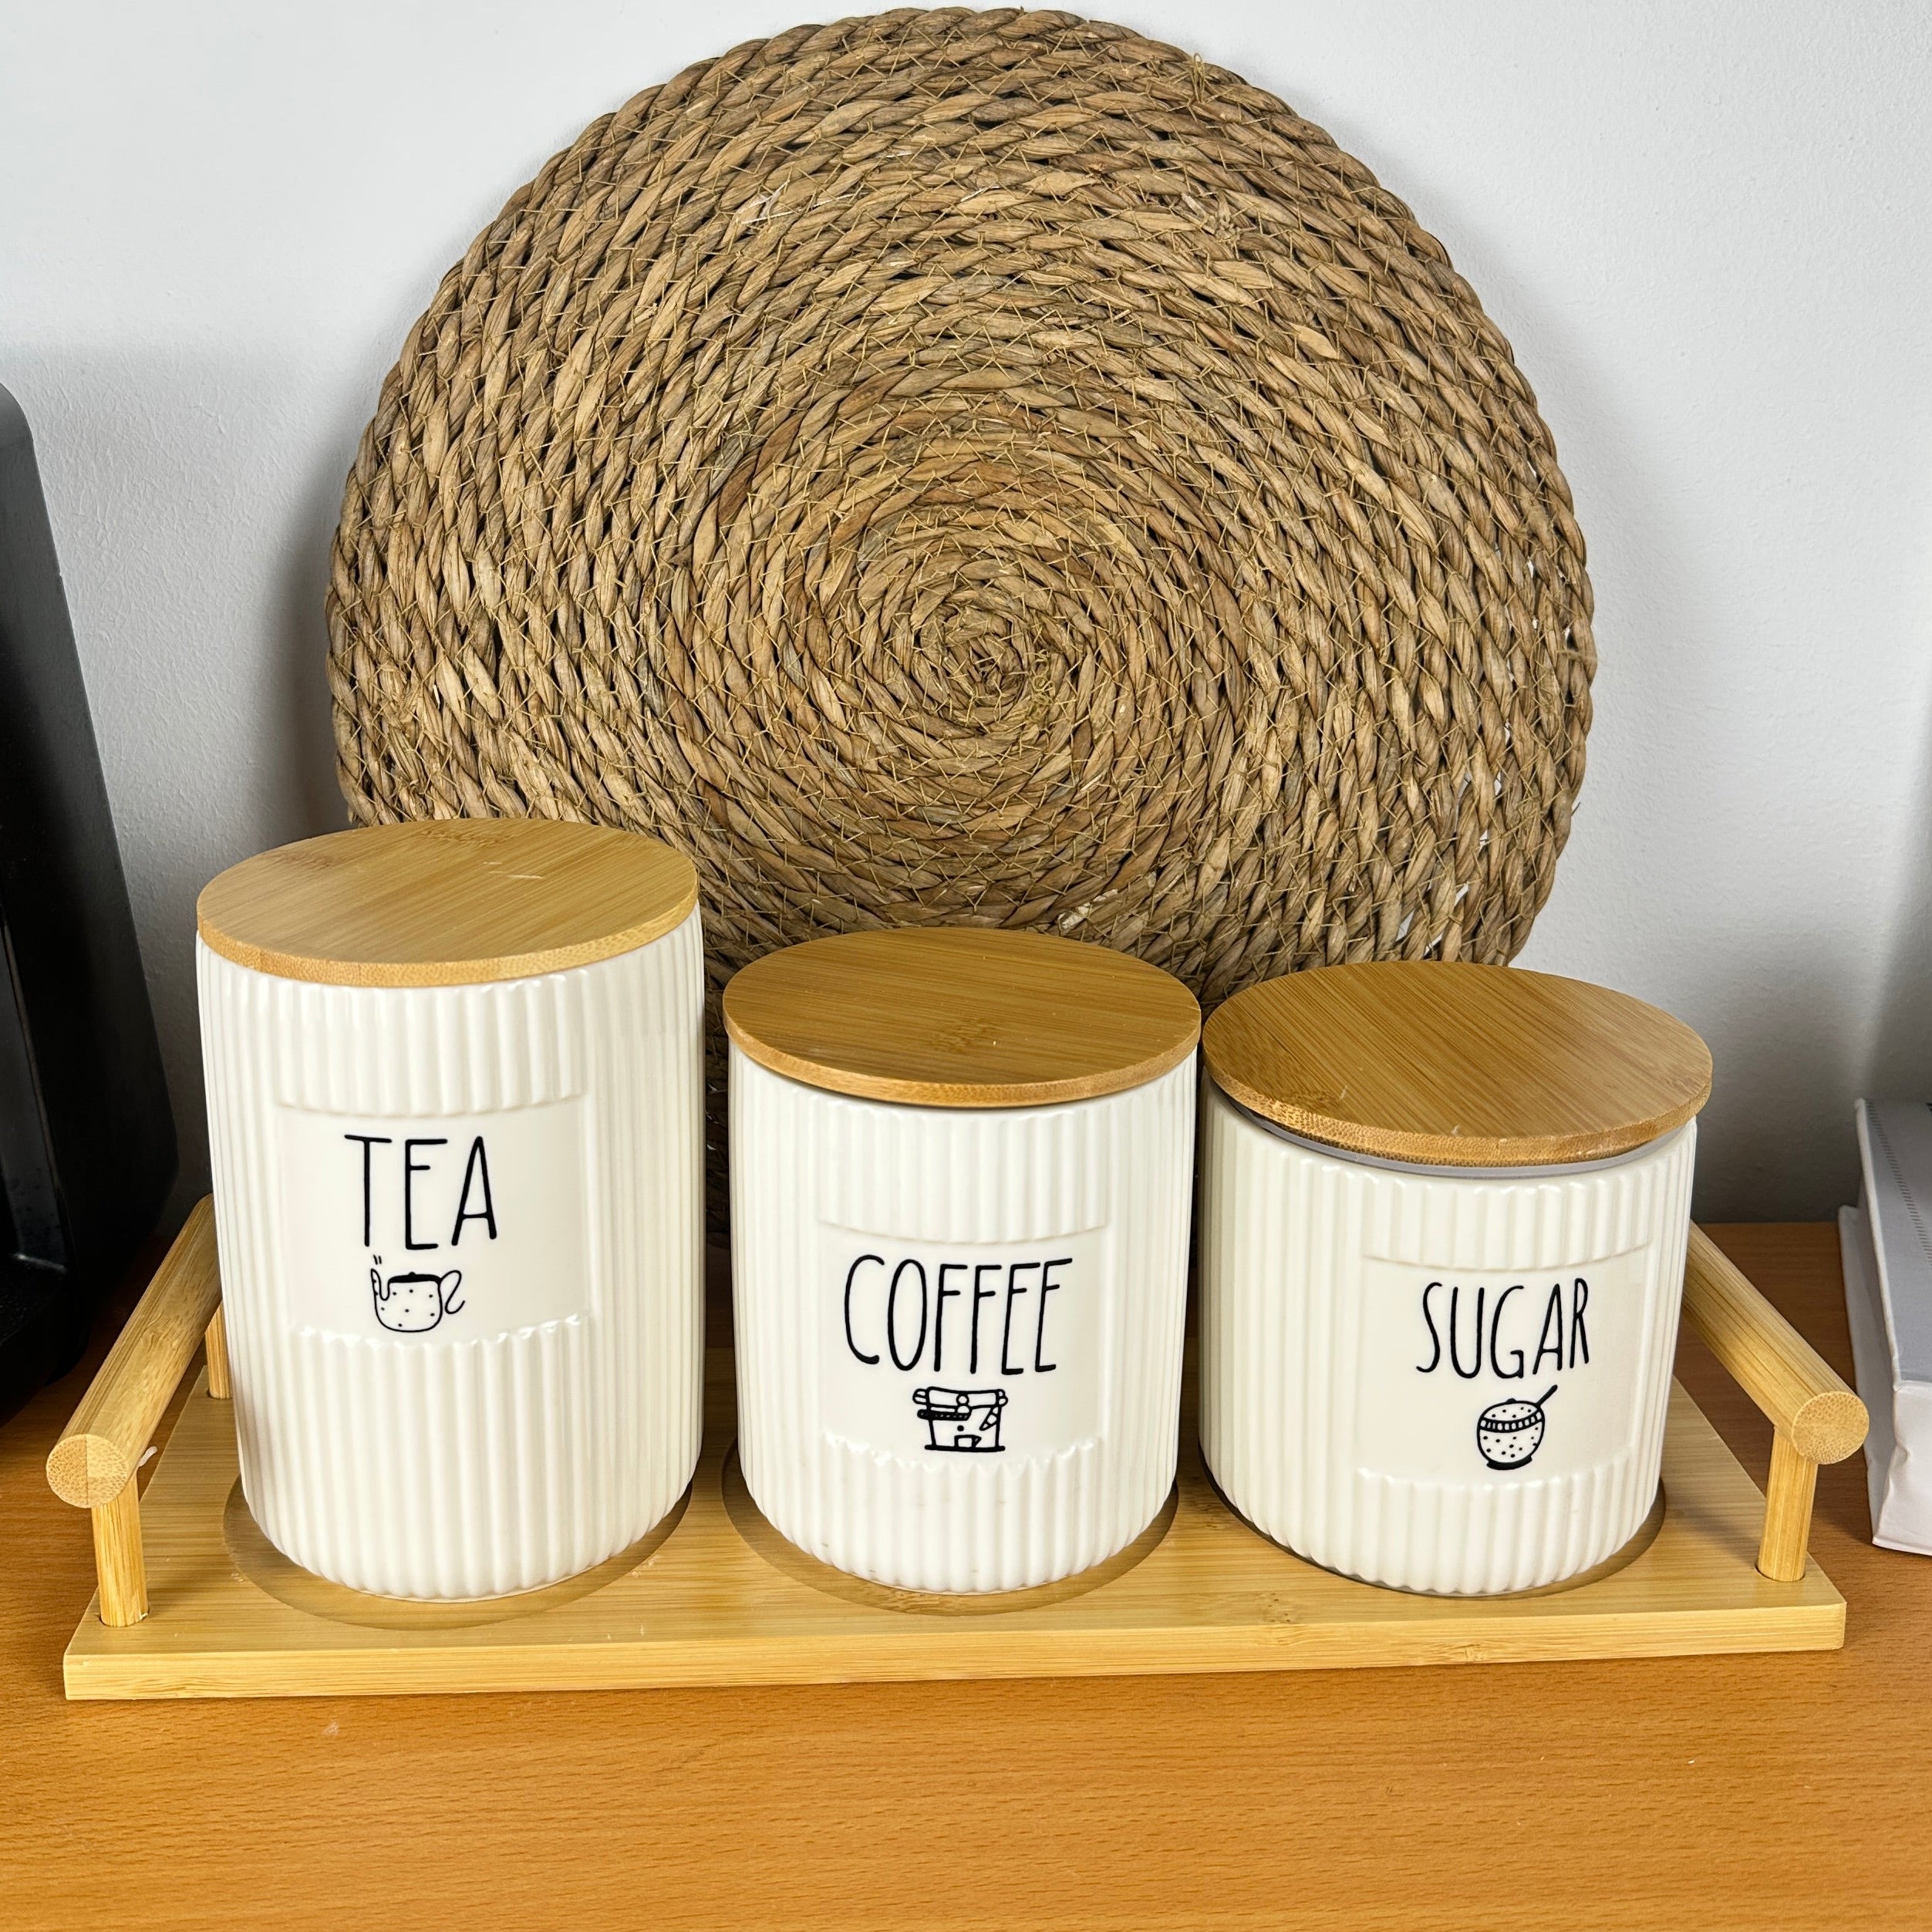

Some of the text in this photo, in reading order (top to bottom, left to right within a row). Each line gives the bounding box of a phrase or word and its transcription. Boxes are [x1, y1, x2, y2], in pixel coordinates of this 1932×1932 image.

[344, 1135, 497, 1251] TEA
[844, 1254, 1073, 1376] COFFEE
[1416, 1277, 1590, 1379] SUGAR
